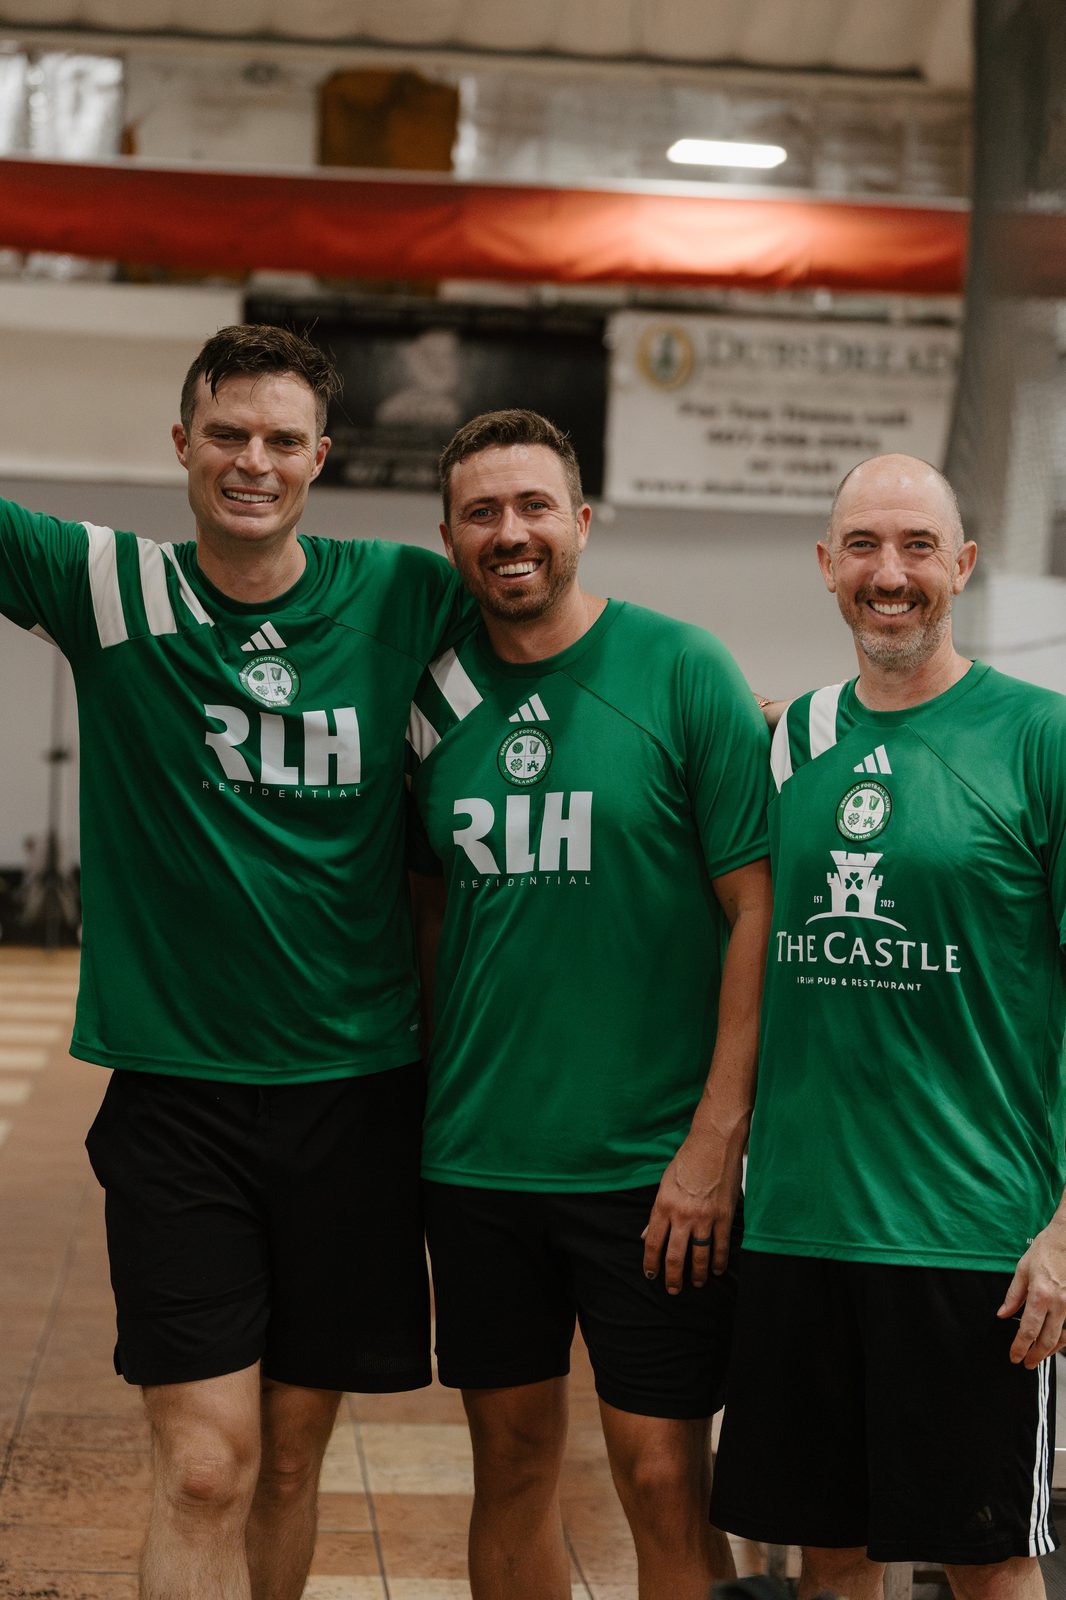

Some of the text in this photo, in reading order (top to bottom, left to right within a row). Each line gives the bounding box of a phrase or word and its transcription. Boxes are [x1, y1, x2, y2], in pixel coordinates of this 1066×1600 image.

[203, 703, 362, 786] RLH
[202, 780, 361, 798] RESIDENTIAL
[452, 791, 593, 875] RLH
[460, 876, 591, 889] RESIDENTIAL
[813, 895, 823, 903] EST
[880, 899, 895, 908] 2023
[776, 930, 962, 973] THE CASTLE
[817, 977, 837, 986] PUB
[841, 978, 847, 986] &
[851, 978, 922, 991] RESTAURANT
